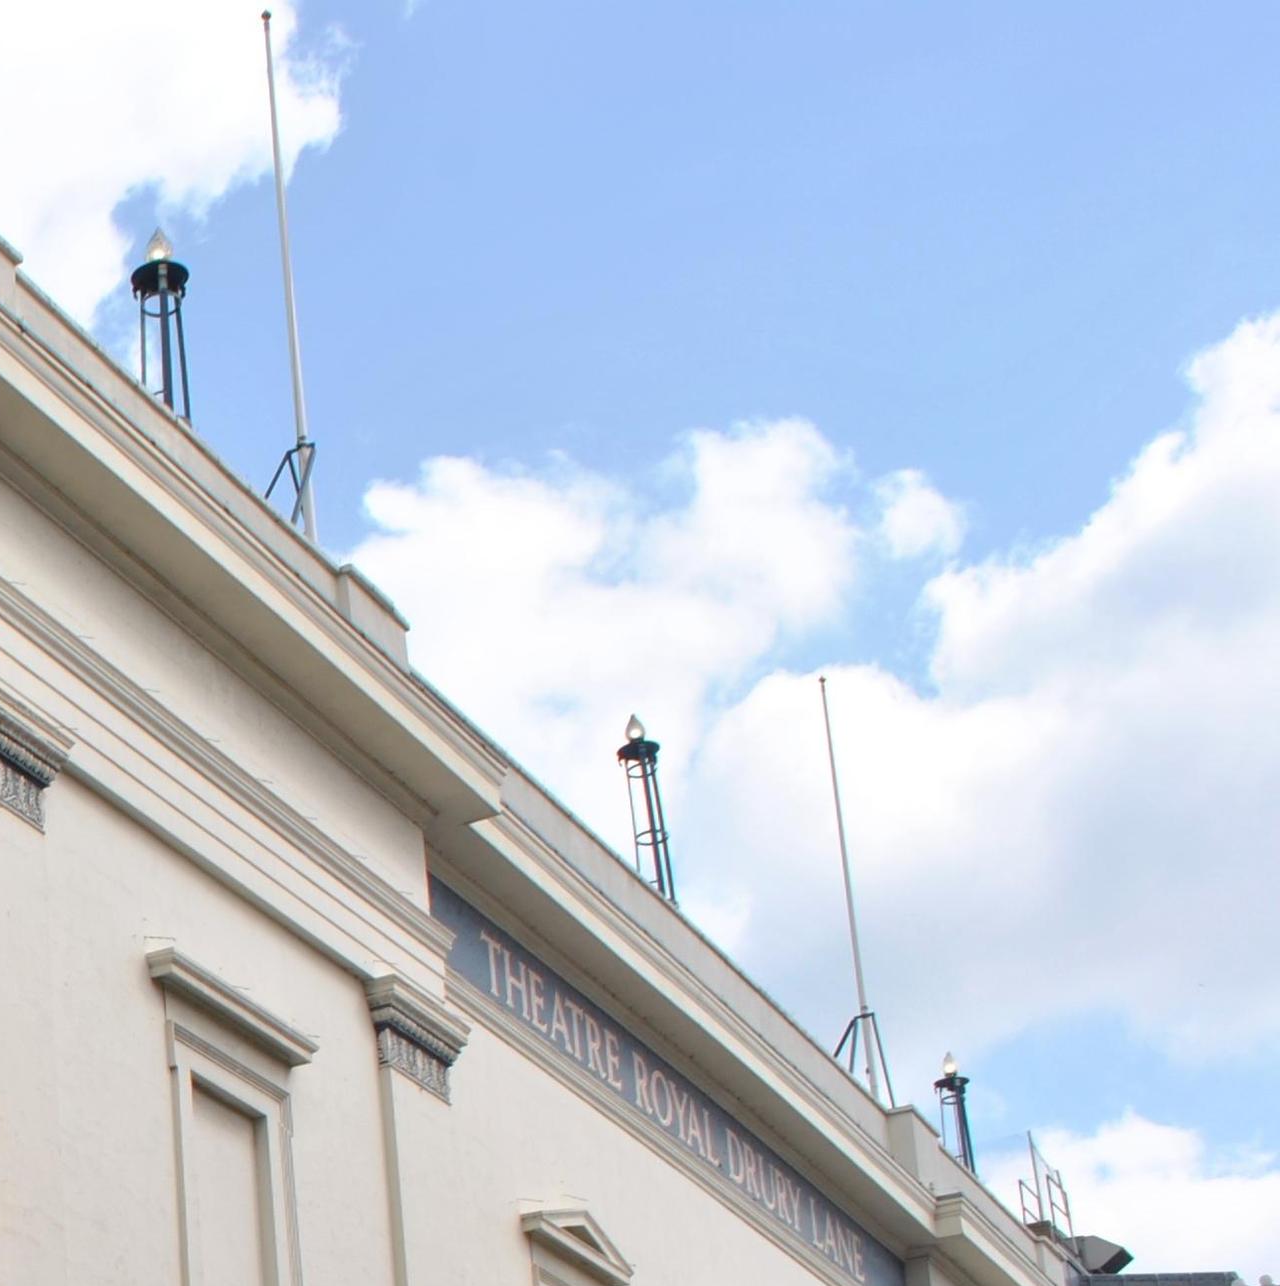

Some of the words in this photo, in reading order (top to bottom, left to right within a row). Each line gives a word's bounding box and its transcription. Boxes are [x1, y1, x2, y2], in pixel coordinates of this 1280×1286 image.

[479, 930, 623, 1090] THEATRE
[634, 1050, 722, 1167] ROYAL
[726, 1128, 803, 1219] DRURY
[809, 1203, 866, 1283] LANE
